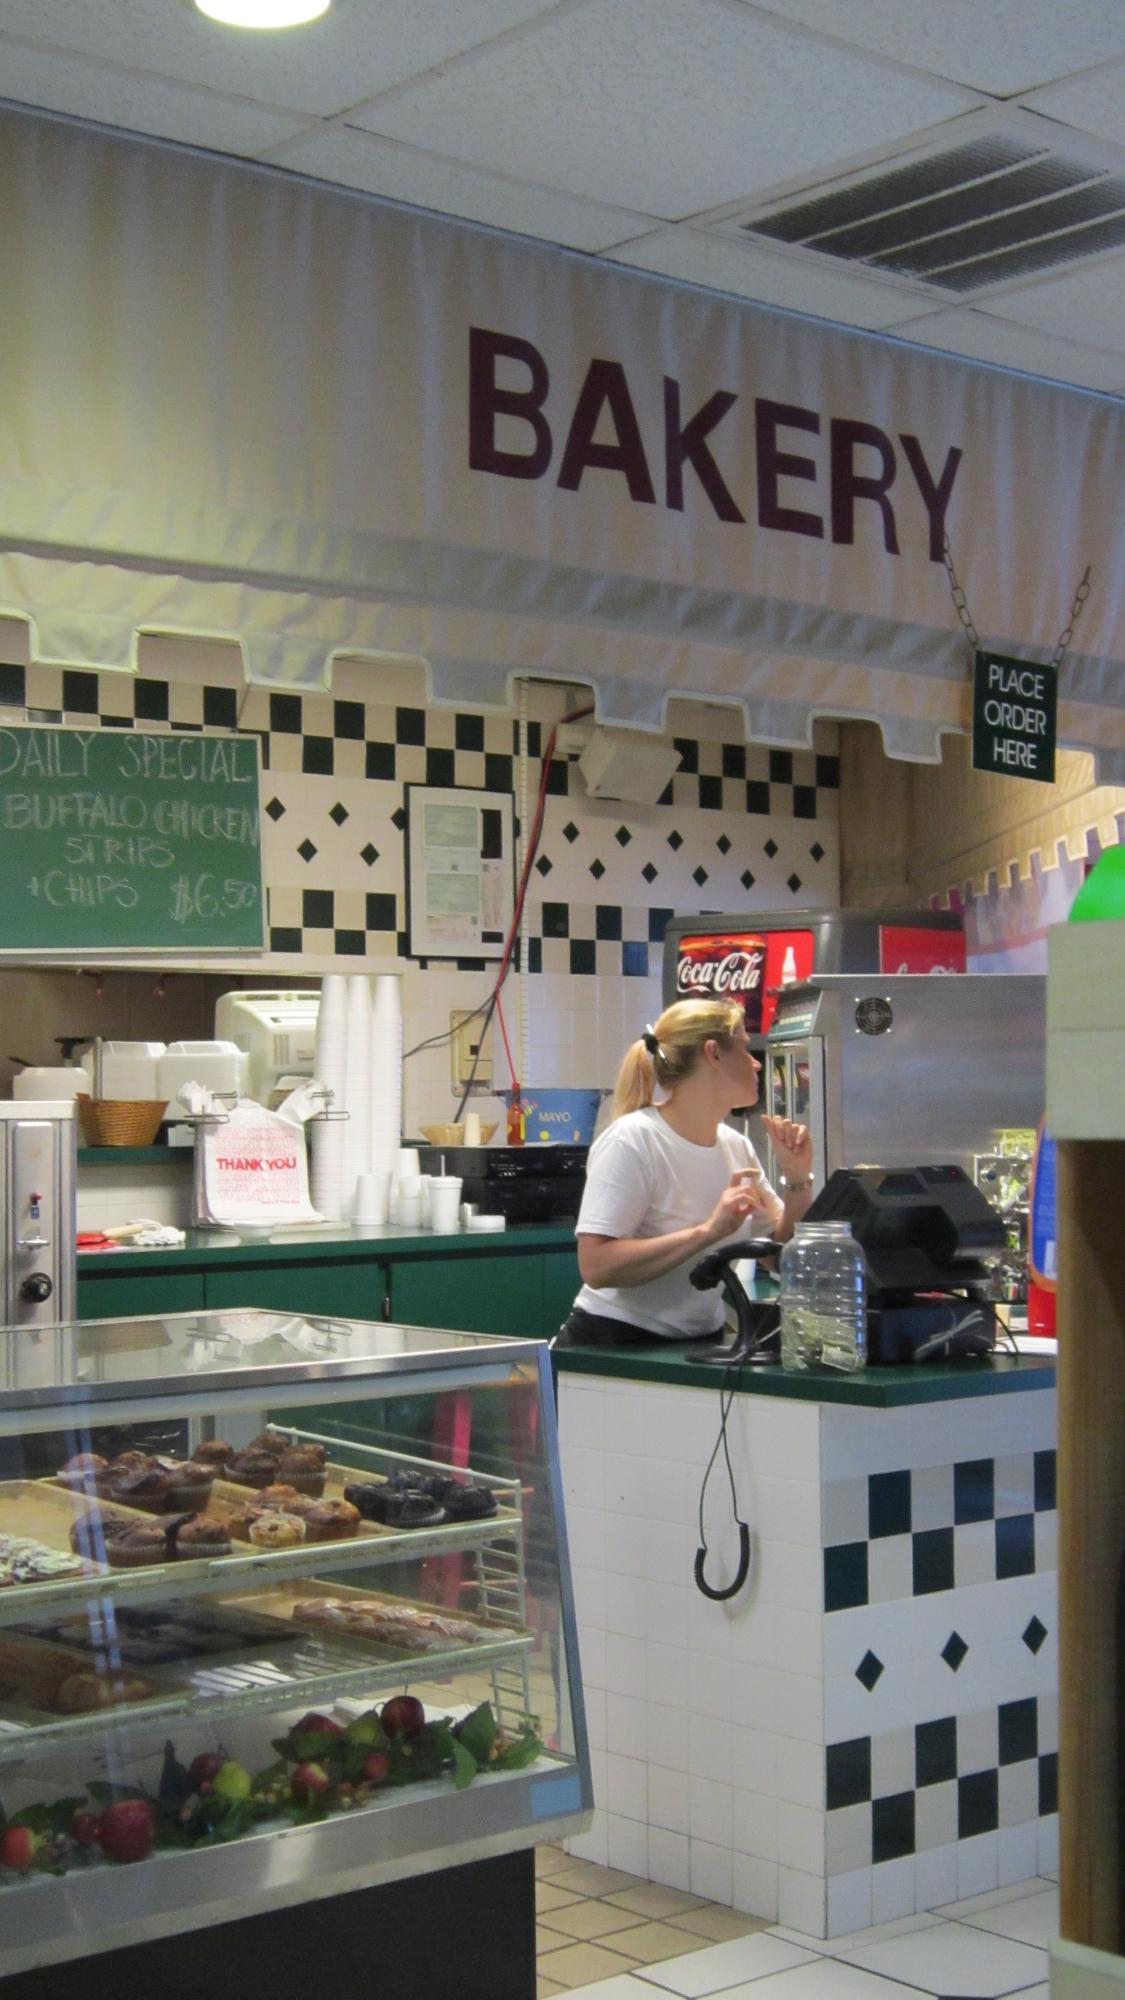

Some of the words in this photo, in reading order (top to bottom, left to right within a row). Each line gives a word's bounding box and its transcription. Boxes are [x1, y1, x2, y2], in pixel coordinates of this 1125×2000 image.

[469, 327, 962, 563] BAKERY
[989, 664, 1044, 699] PLACE
[984, 699, 1047, 735] ORDER
[0, 730, 95, 777] DAILY
[119, 735, 251, 782] SPECIAL
[993, 737, 1037, 769] HERE
[3, 792, 147, 829] BUFFALO
[153, 799, 258, 845] CHICKEN
[64, 833, 175, 868] STRIPS
[170, 873, 257, 923] $6.50
[677, 952, 763, 993] Coca-Cola
[539, 1111, 572, 1122] MAYO
[216, 1157, 263, 1171] THANK
[265, 1157, 297, 1171] YOU
